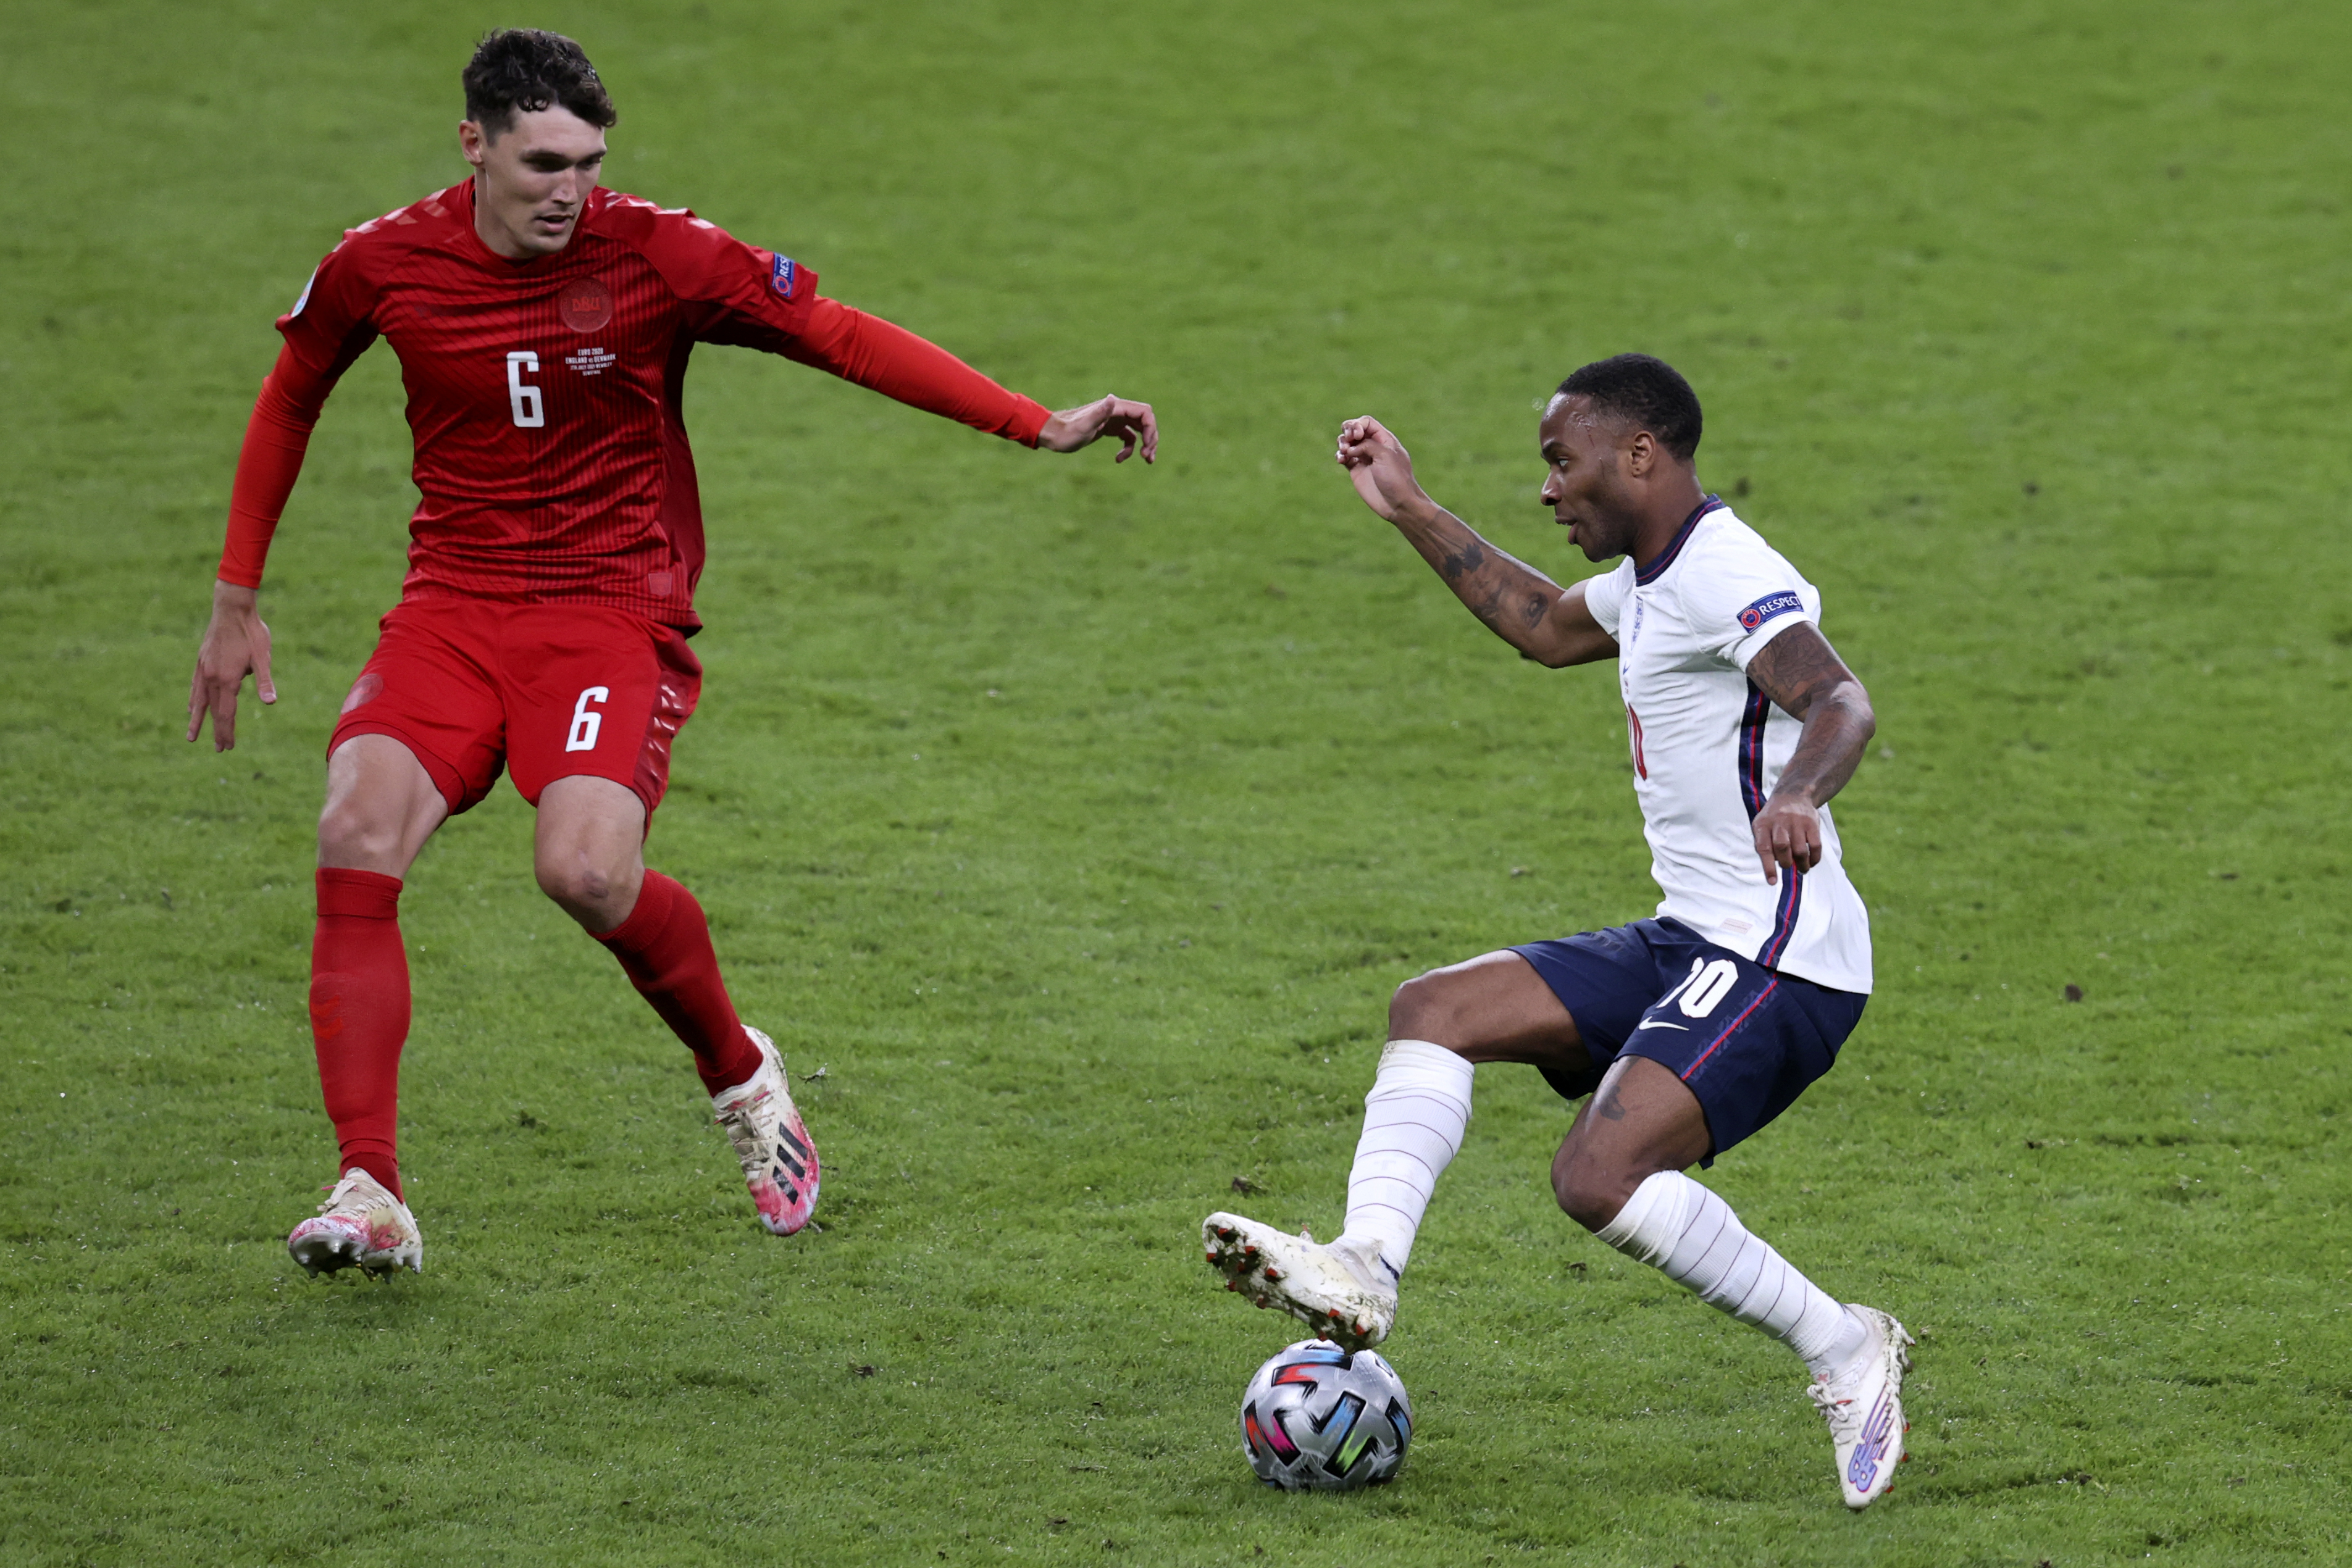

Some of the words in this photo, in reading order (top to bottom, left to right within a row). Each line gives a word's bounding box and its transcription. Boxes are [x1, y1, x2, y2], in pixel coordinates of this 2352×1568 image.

[594, 354, 616, 363] DENMARK
[506, 351, 545, 428] 6
[1759, 596, 1801, 615] RESPECT
[565, 685, 610, 753] 6
[1656, 957, 1739, 1018] 10
